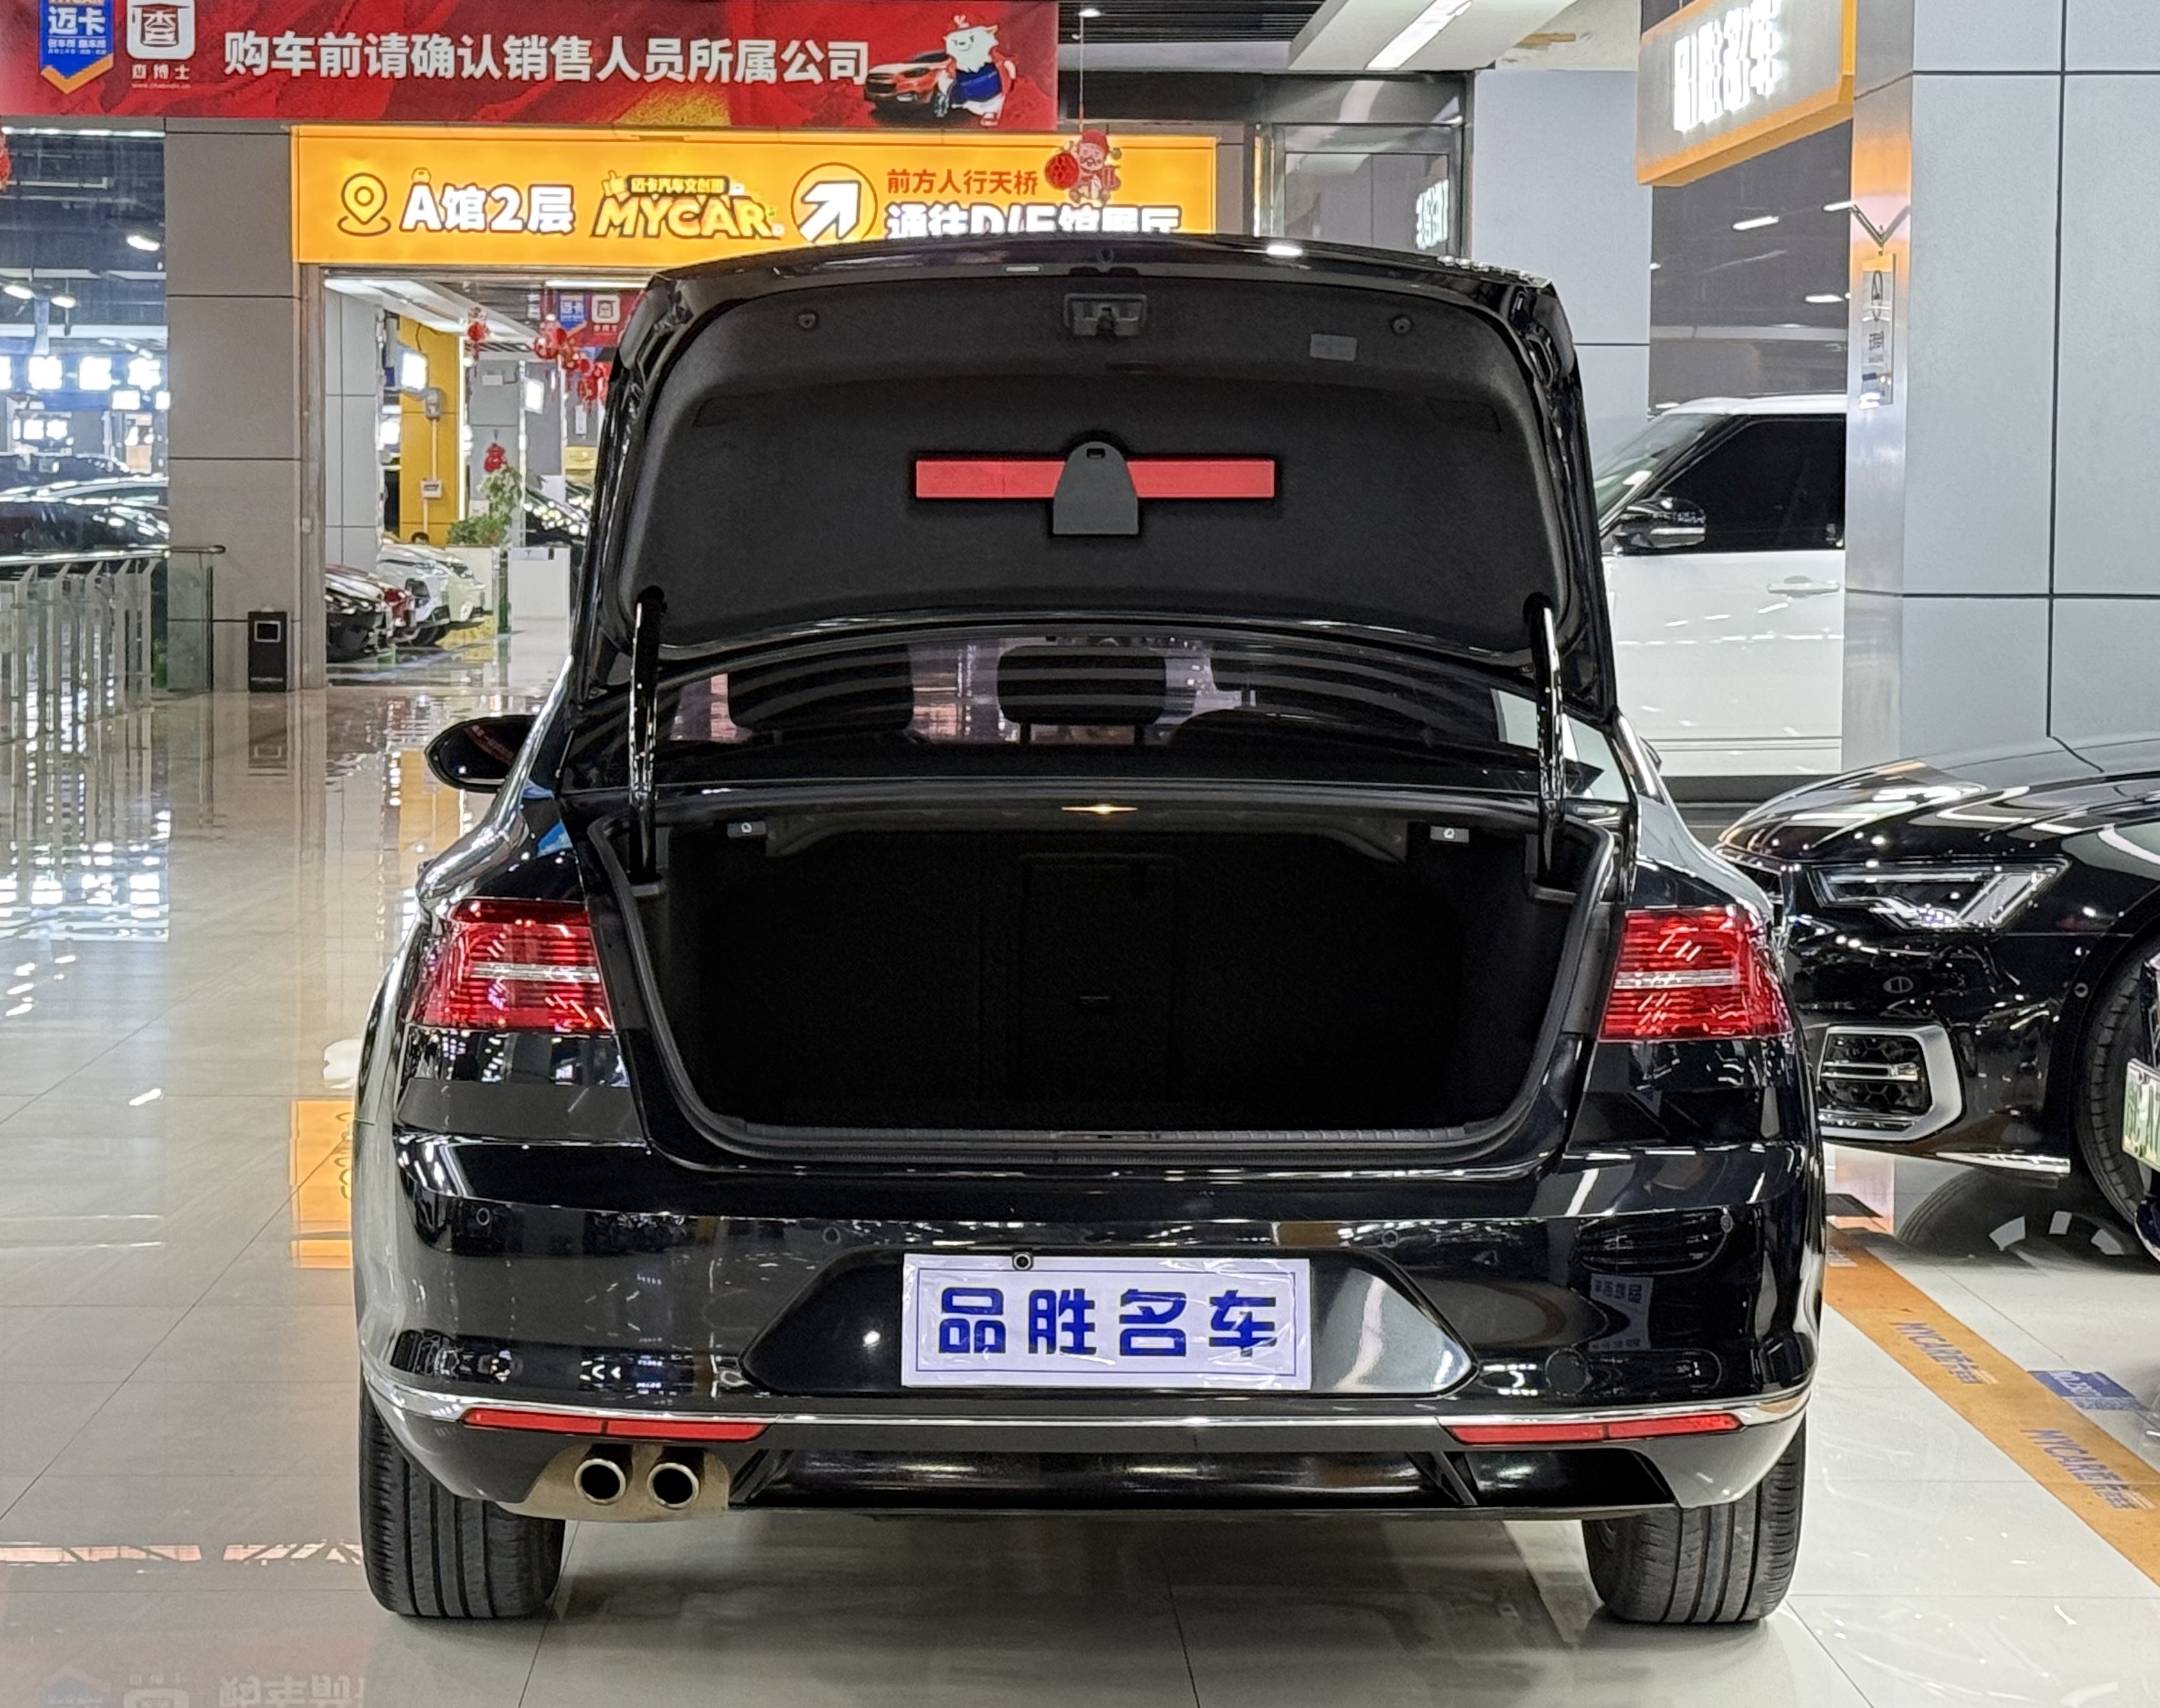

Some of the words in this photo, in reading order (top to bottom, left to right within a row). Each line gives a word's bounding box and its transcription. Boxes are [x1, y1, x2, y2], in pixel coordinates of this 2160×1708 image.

[48, 6, 106, 35] 迈卡
[224, 31, 868, 85] 购车前请确认销售人员所属公司
[887, 169, 1038, 195] 前方人行天桥
[400, 183, 576, 235] A馆2层
[590, 194, 777, 238] MYCAR
[938, 1287, 1277, 1357] 品胜名车
